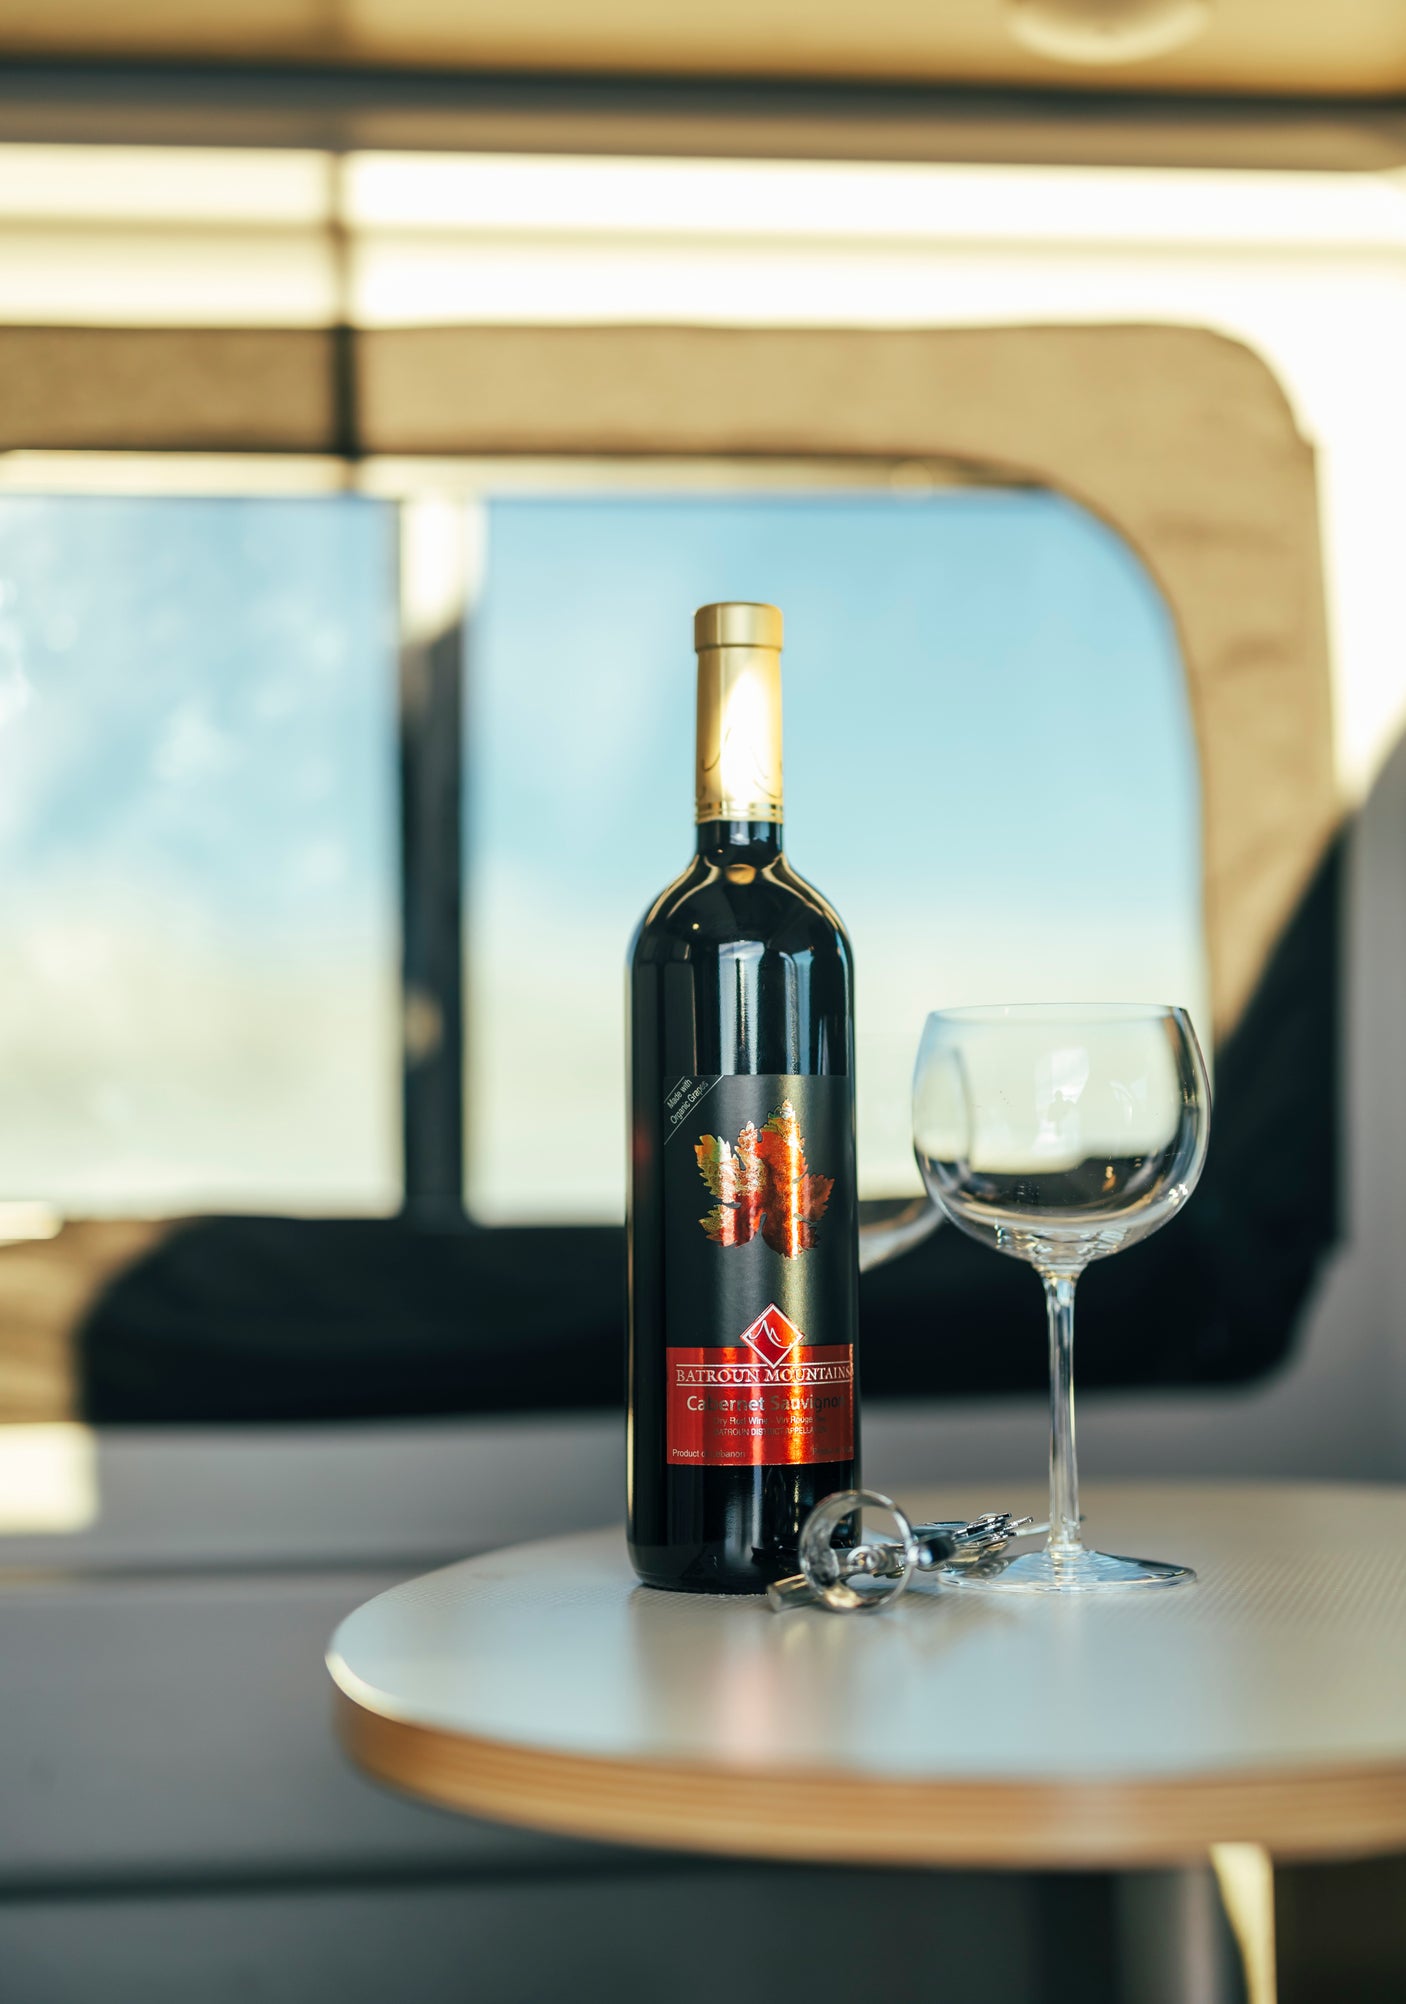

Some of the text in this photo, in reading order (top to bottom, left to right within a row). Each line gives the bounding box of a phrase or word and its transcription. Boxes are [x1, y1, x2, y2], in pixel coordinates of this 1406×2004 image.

[666, 1091, 682, 1109] Made
[670, 1101, 691, 1124] Organic
[676, 1366, 852, 1383] BATROUN MOUNTAINS
[687, 1395, 765, 1411] Cabernet
[672, 1448, 700, 1457] Product
